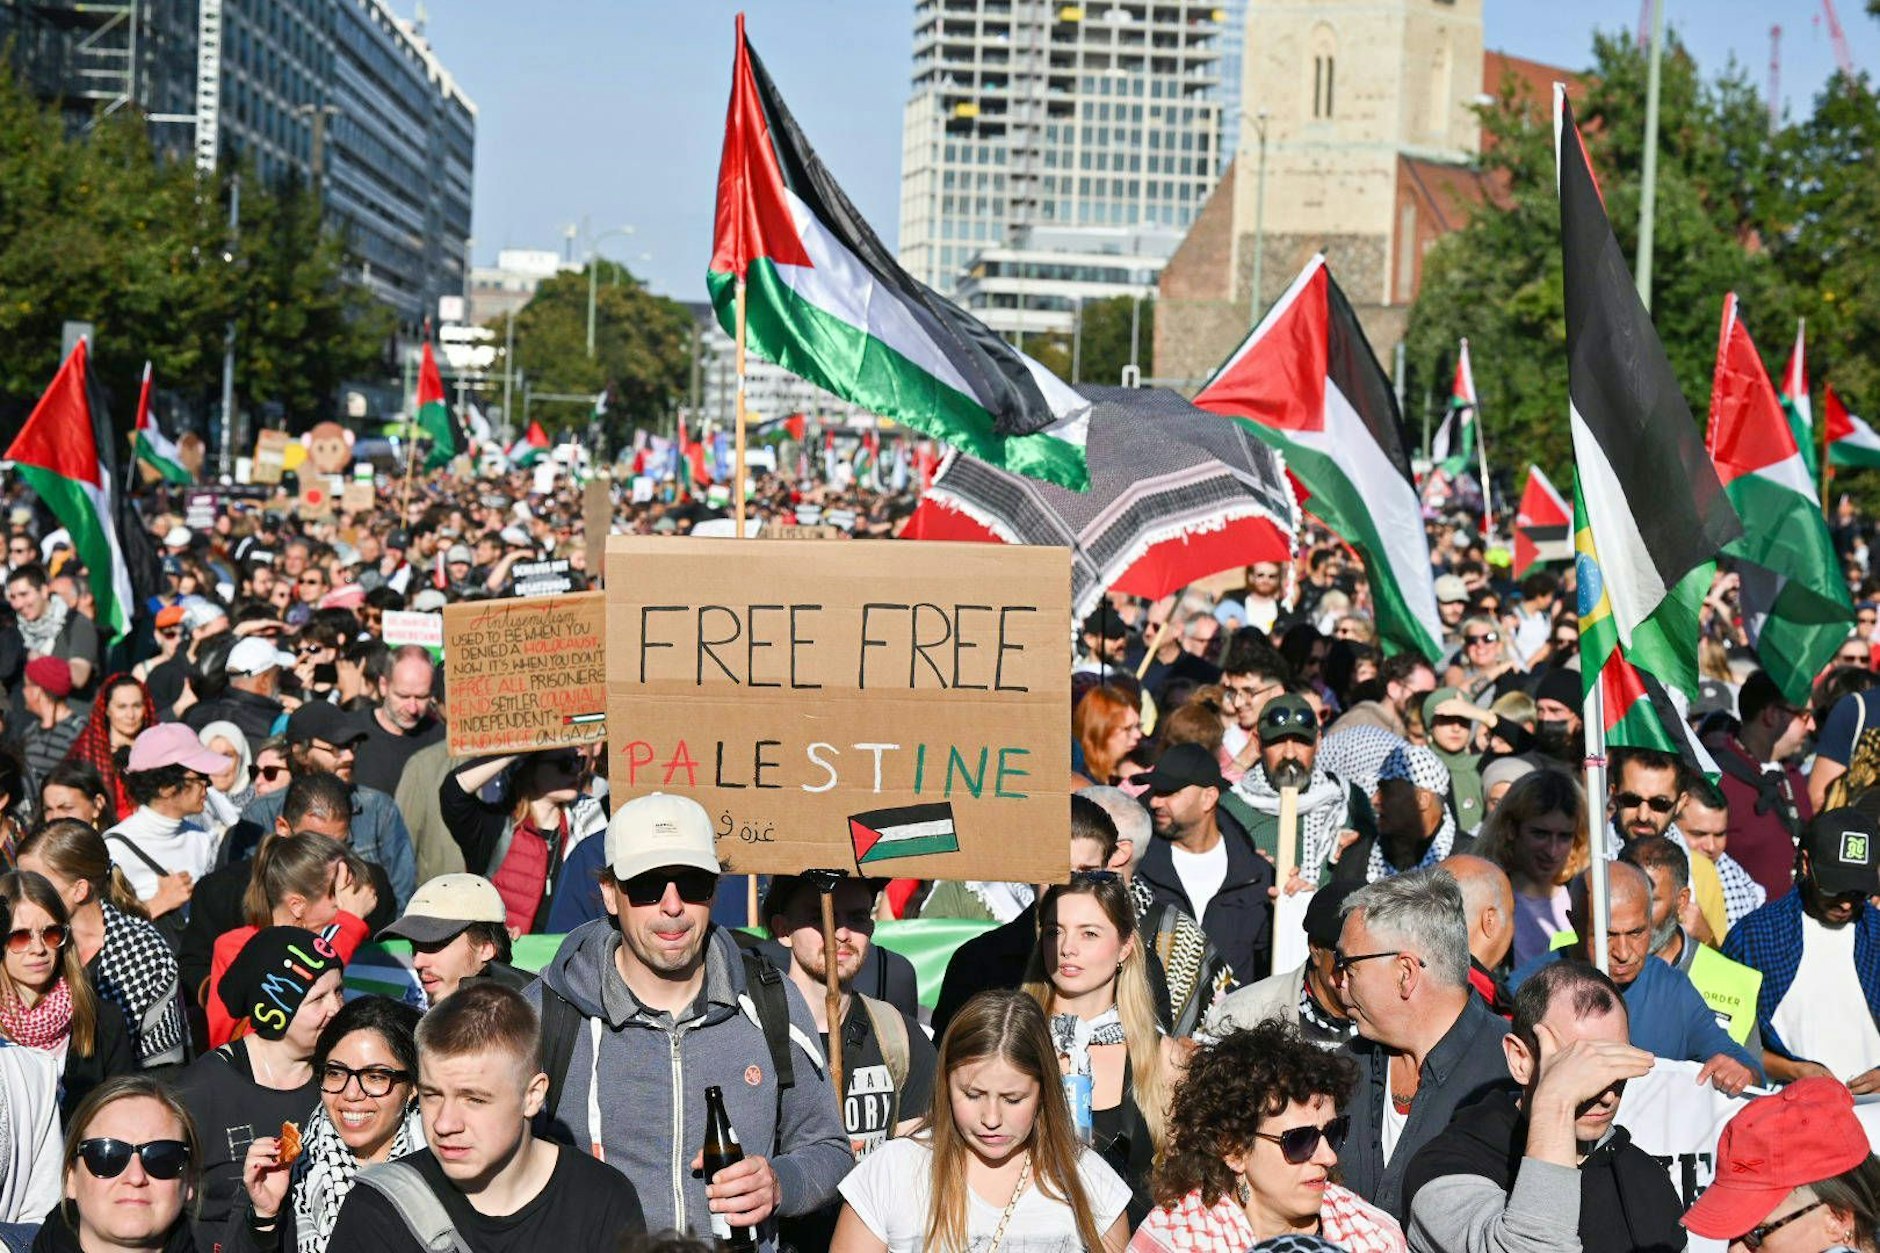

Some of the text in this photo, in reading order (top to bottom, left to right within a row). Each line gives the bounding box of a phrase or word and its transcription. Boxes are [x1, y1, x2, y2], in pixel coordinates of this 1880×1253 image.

[470, 600, 577, 630] Antisemitism
[451, 631, 484, 647] USED
[487, 630, 500, 643] TO
[504, 627, 523, 643] BE
[523, 624, 560, 641] WHEN
[565, 621, 591, 636] YOU
[461, 643, 508, 661] DENIED
[510, 643, 521, 656] A
[640, 603, 1037, 692] FREE FREE
[453, 650, 605, 675] NOW IT'S WHEN YOU DON'T
[458, 668, 606, 697] FREE ALL PRISONERS
[458, 695, 491, 716] END
[491, 693, 539, 714] SETTLER
[458, 723, 608, 750] END SIEGE ON GAZA
[621, 739, 1031, 798] PALESTINE
[741, 821, 775, 843] غزة
[1703, 991, 1741, 1007] ORDER
[845, 1093, 890, 1132] ORY
